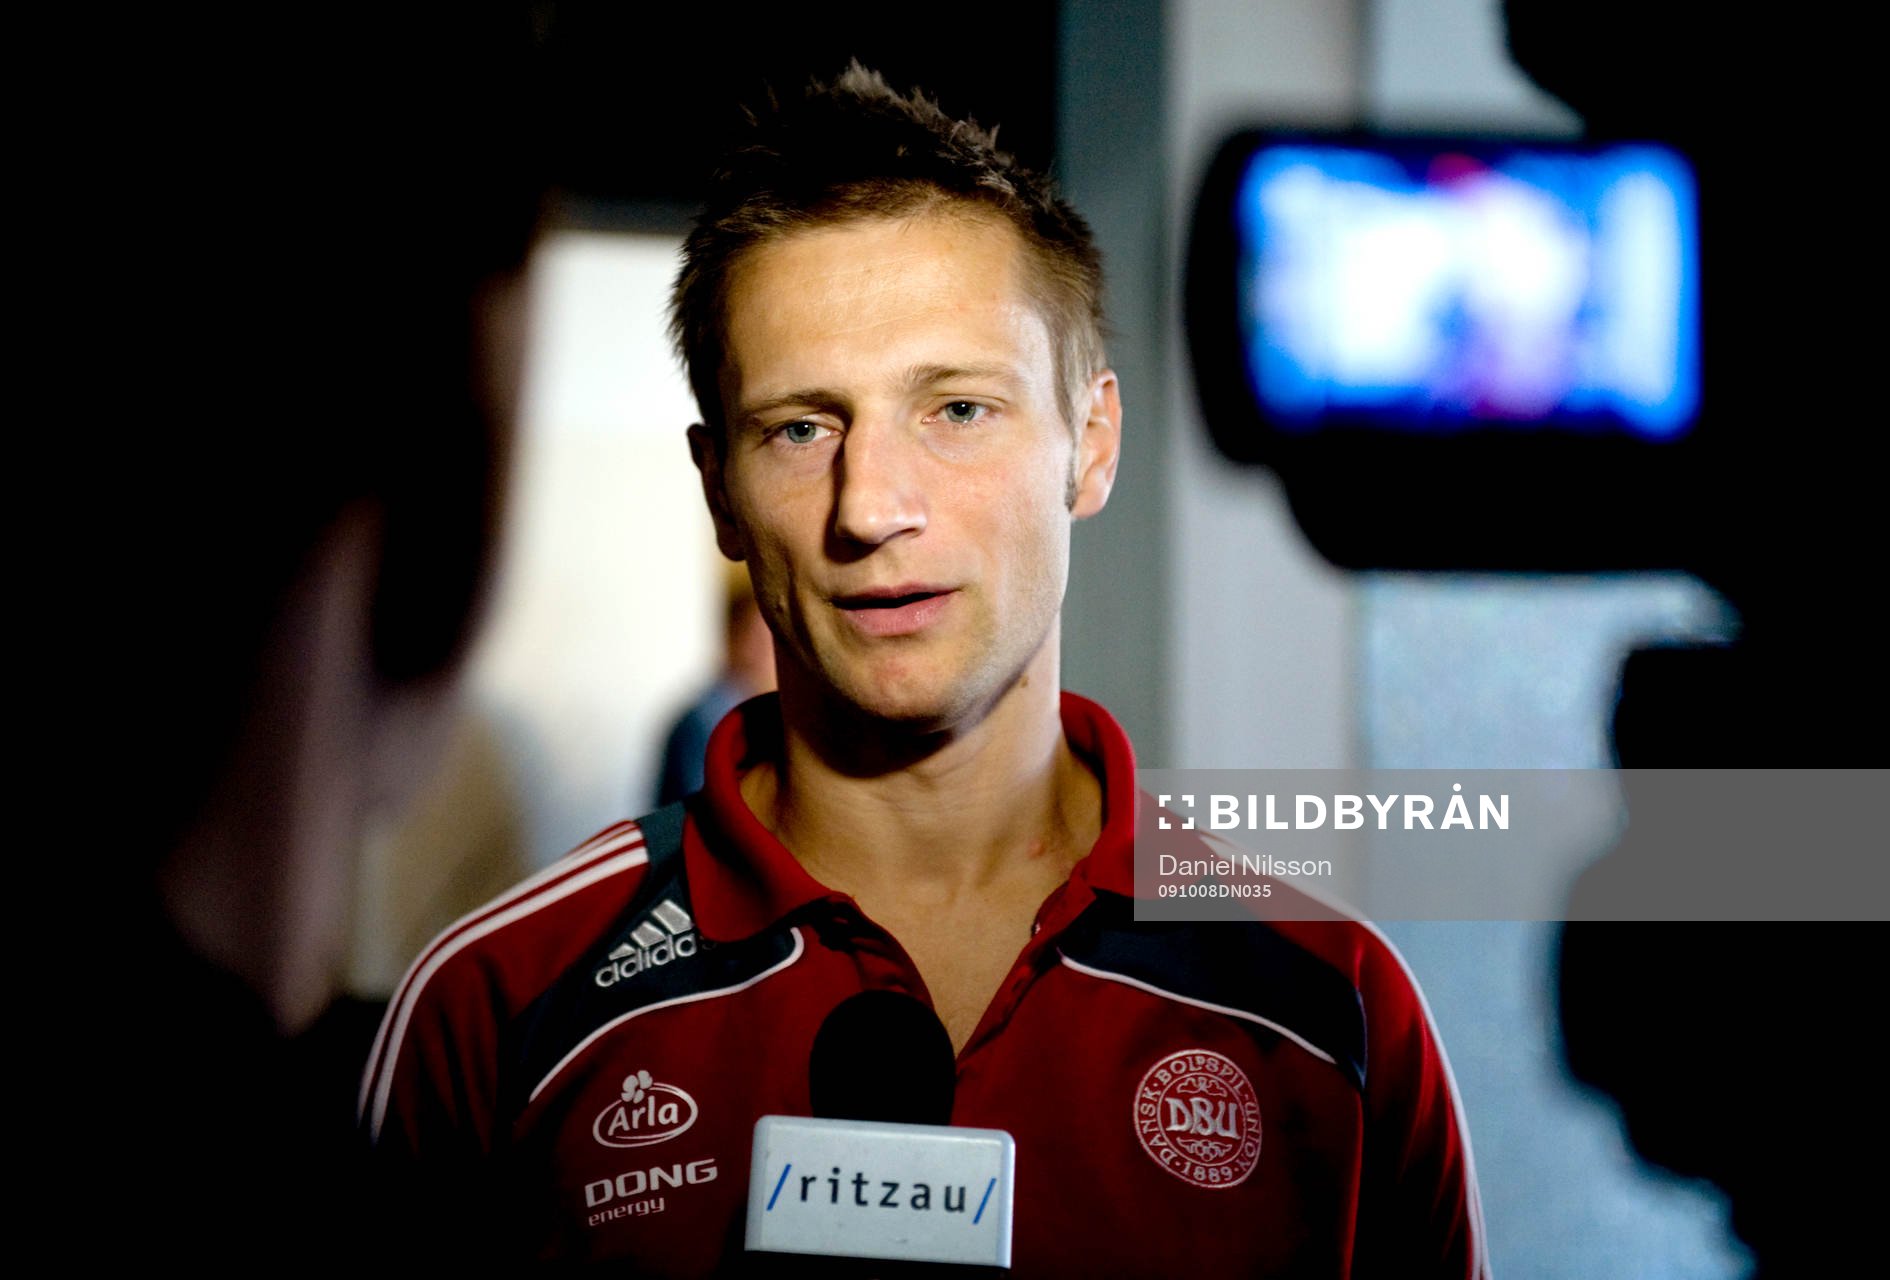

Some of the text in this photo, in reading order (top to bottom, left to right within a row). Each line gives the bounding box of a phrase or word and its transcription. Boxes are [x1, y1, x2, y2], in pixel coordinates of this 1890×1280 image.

[608, 1095, 679, 1137] Arla
[1140, 1087, 1177, 1165] DANSK
[1236, 1102, 1259, 1172] UNION
[1165, 1097, 1241, 1140] DBU
[584, 1158, 718, 1208] DONG
[1180, 1161, 1233, 1183] 1889
[588, 1197, 666, 1227] energy
